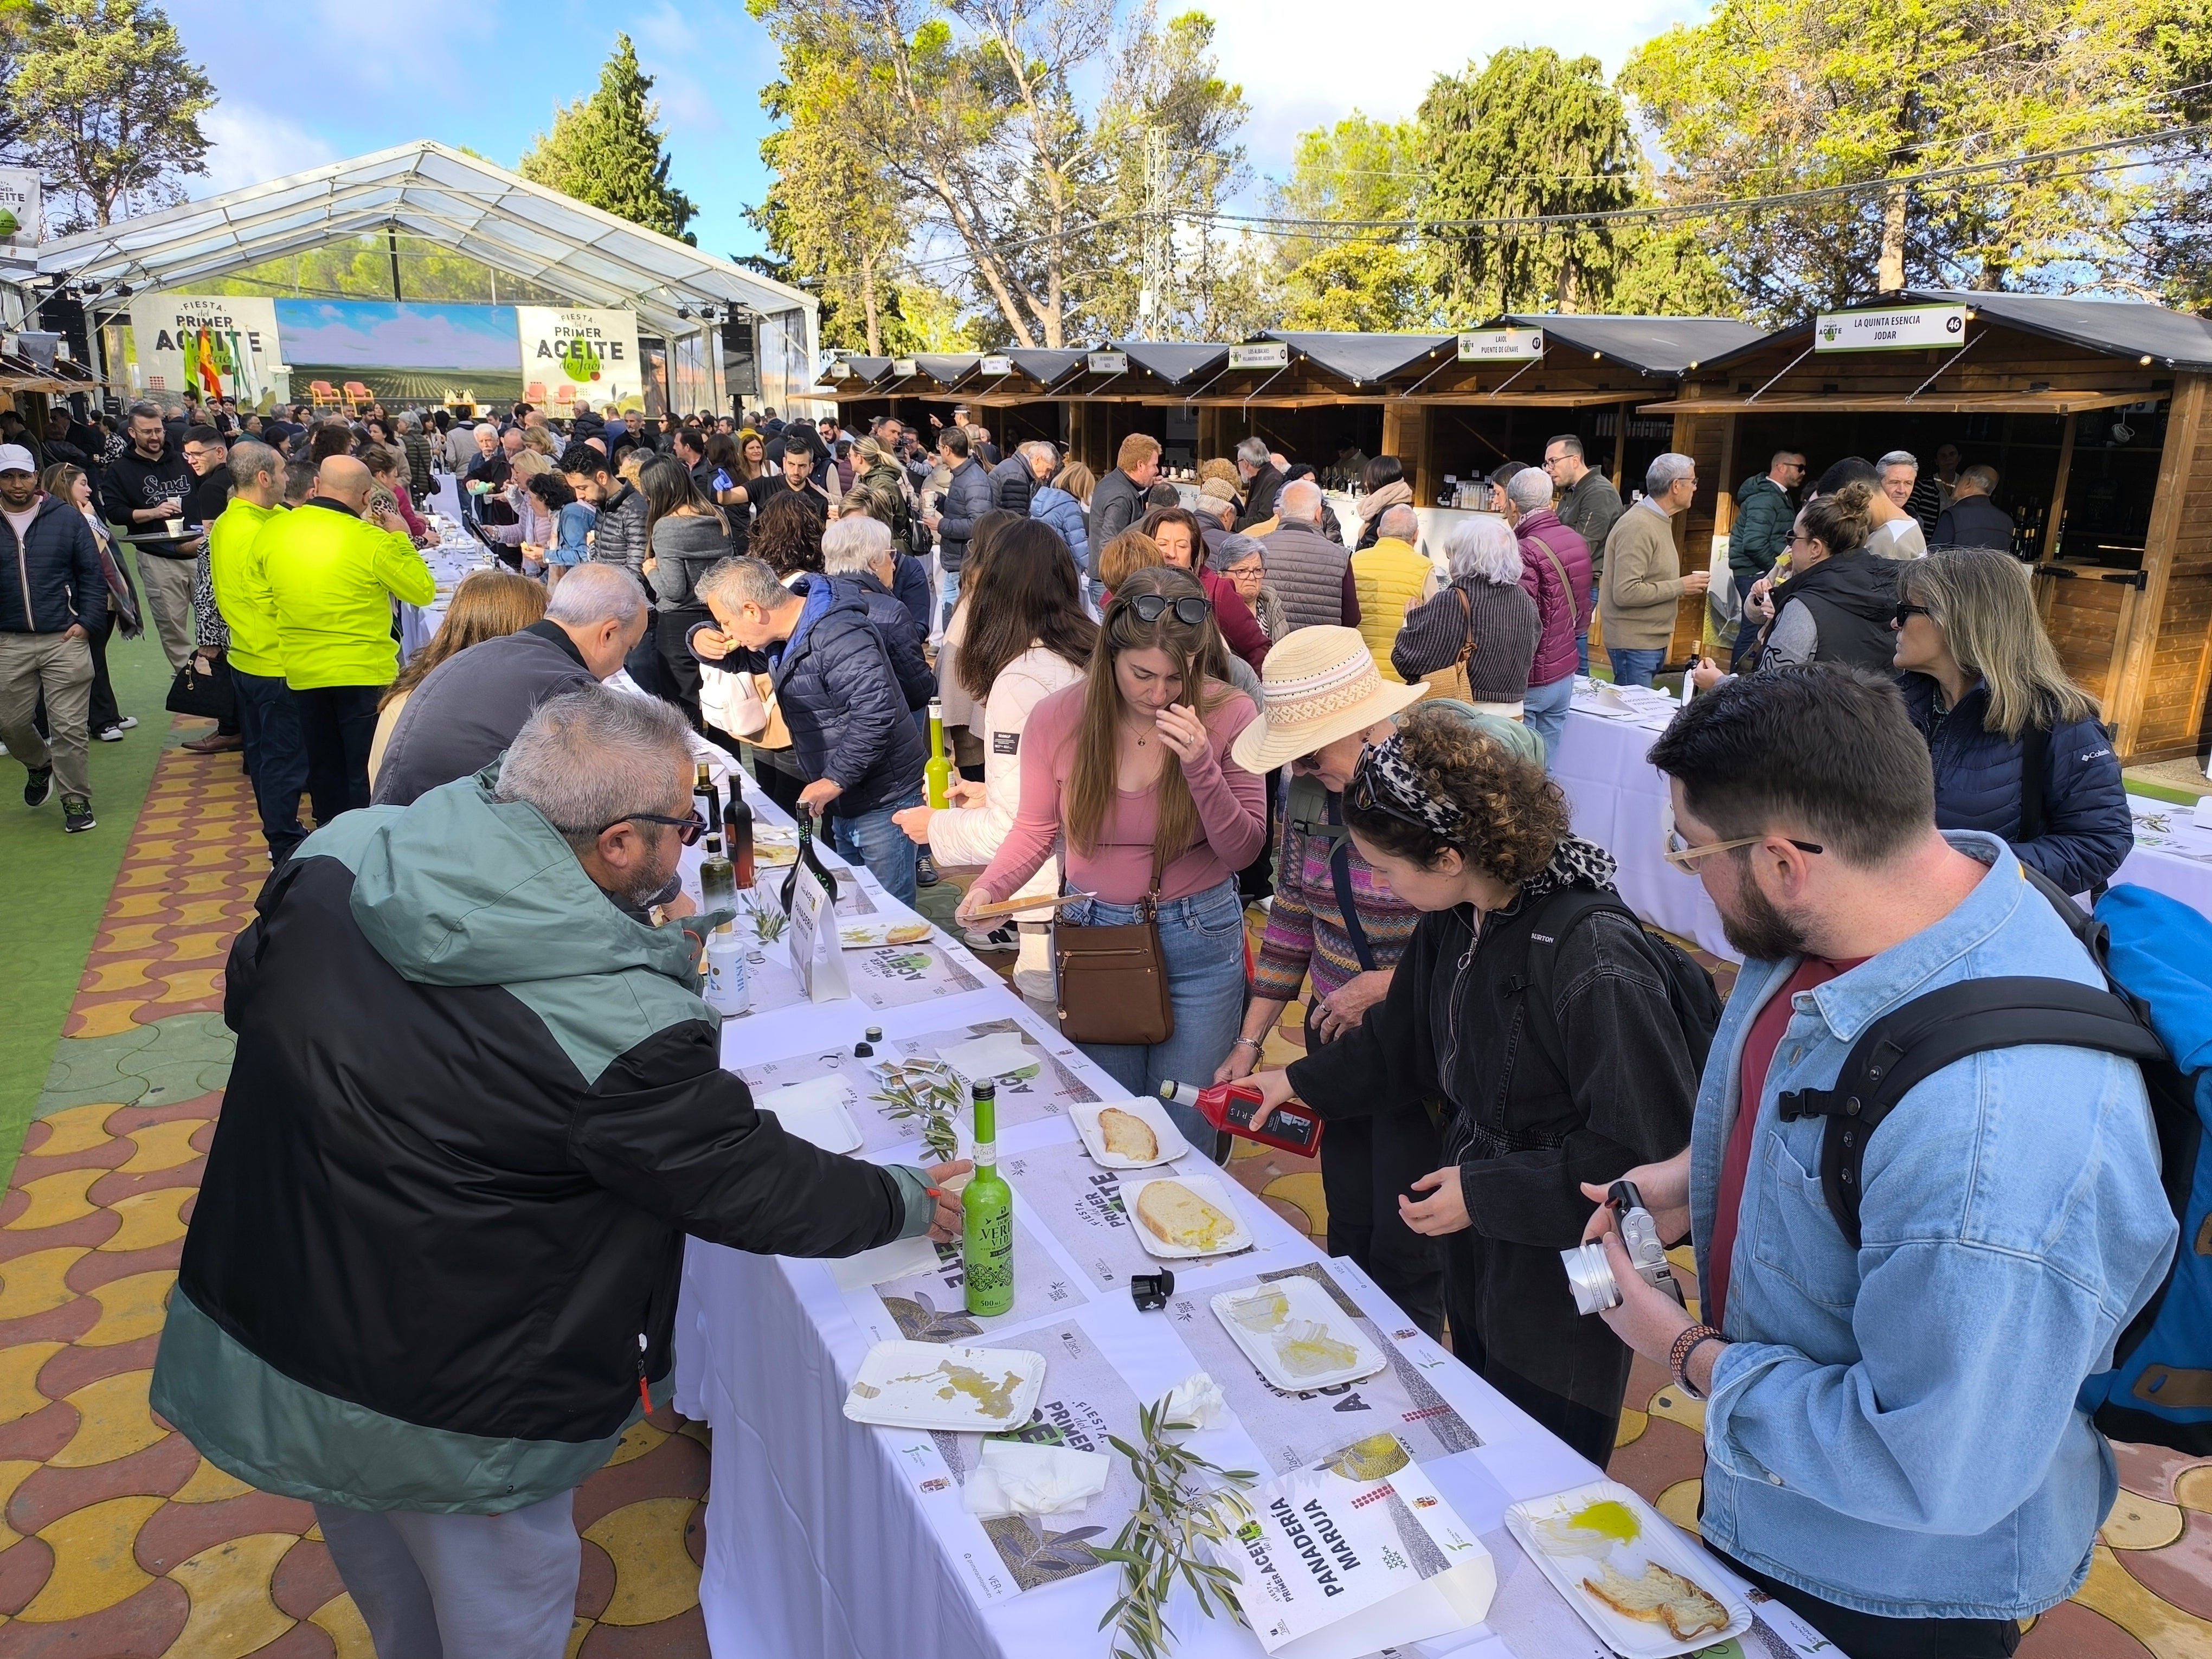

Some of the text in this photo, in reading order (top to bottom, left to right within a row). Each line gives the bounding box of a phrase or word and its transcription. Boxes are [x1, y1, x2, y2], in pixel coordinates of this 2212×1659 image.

[176, 315, 233, 327] PRIMER
[1854, 316, 1920, 327] LA QUINTA ESENCIA
[1948, 319, 1960, 330] 46
[555, 326, 601, 338] PRIMER
[1874, 331, 1896, 340] JODAR
[537, 339, 624, 360] ACEITE
[1533, 339, 1540, 347] 47
[559, 356, 606, 375] de Jaén
[795, 901, 813, 933] PANADERÍA
[1531, 933, 1554, 943] BURTON
[870, 959, 896, 978] PRIMER
[874, 948, 927, 981] ACEITE
[1085, 1192, 1126, 1227] PRIMER
[1044, 1400, 1095, 1452] PRIMER
[1073, 1418, 1092, 1430] del
[1283, 1452, 1301, 1471] Jaén
[1303, 1498, 1361, 1571] MARUJA
[1236, 1525, 1277, 1574] ACEITE
[1270, 1497, 1345, 1597] PANADERÍA
[989, 1576, 1001, 1590] VER
[1272, 1573, 1294, 1603] PRIMER
[1277, 1622, 1288, 1636] Jaén
[1790, 1621, 1815, 1644] DIPUTACIÓN
